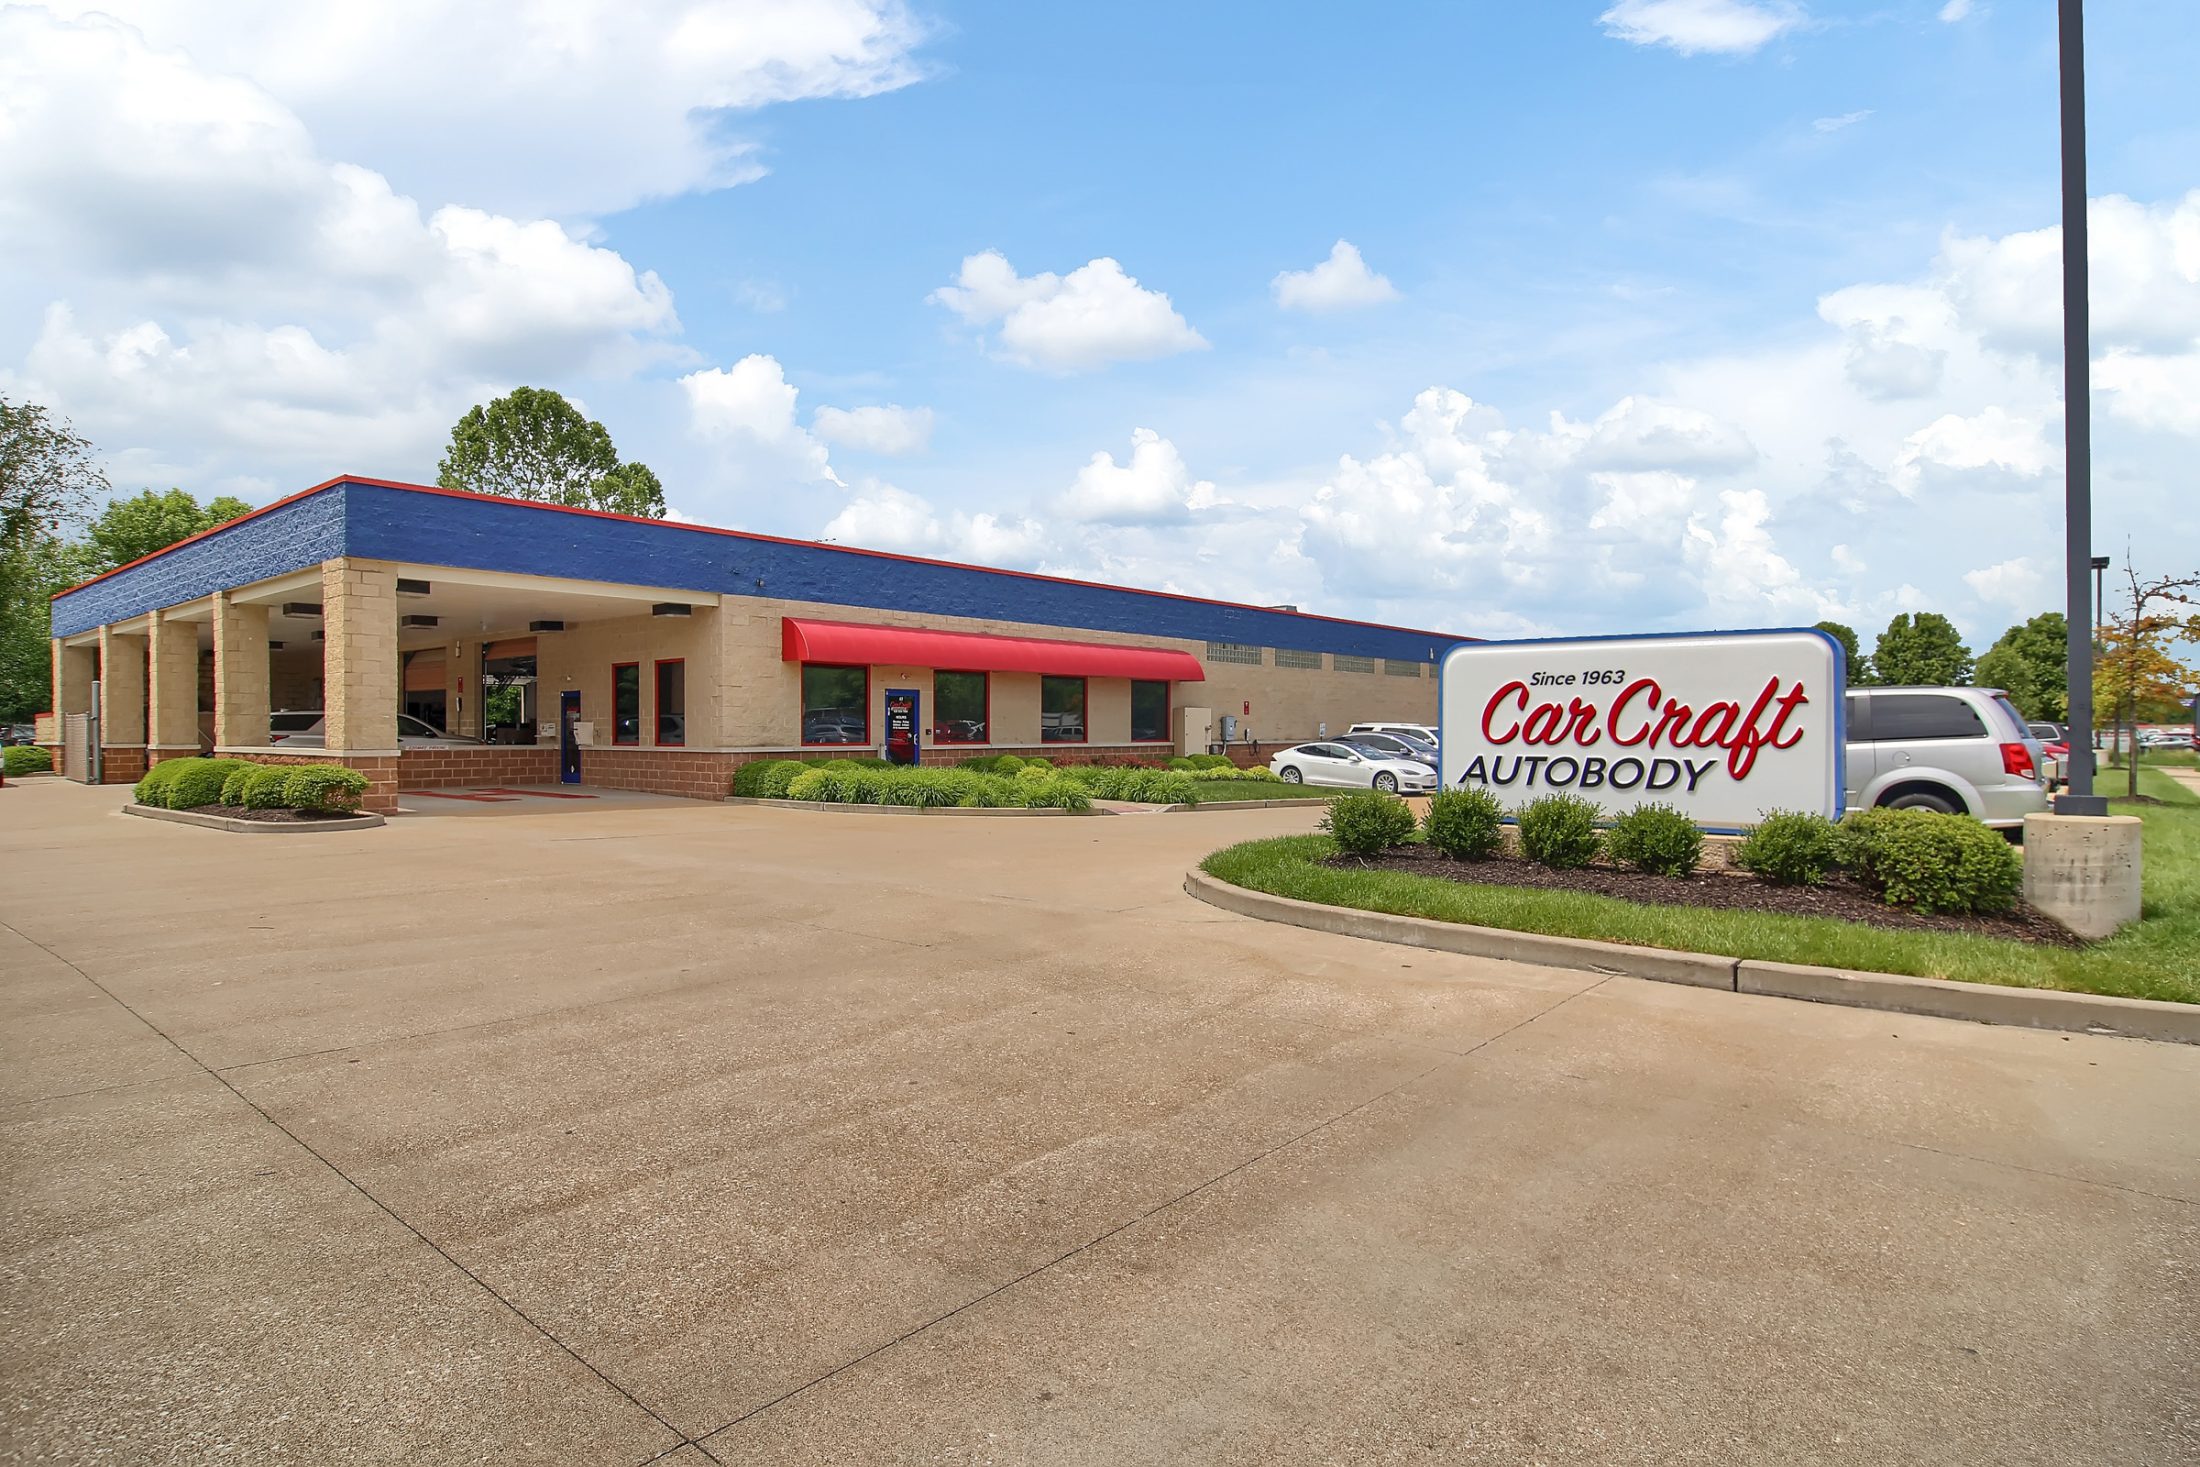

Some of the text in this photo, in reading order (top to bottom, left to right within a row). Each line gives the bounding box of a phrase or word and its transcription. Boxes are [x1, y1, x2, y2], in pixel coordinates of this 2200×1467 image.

[1530, 669, 1625, 686] Since 1963
[1481, 676, 1809, 780] Car Craft
[1457, 755, 1718, 792] AUTOBODY
